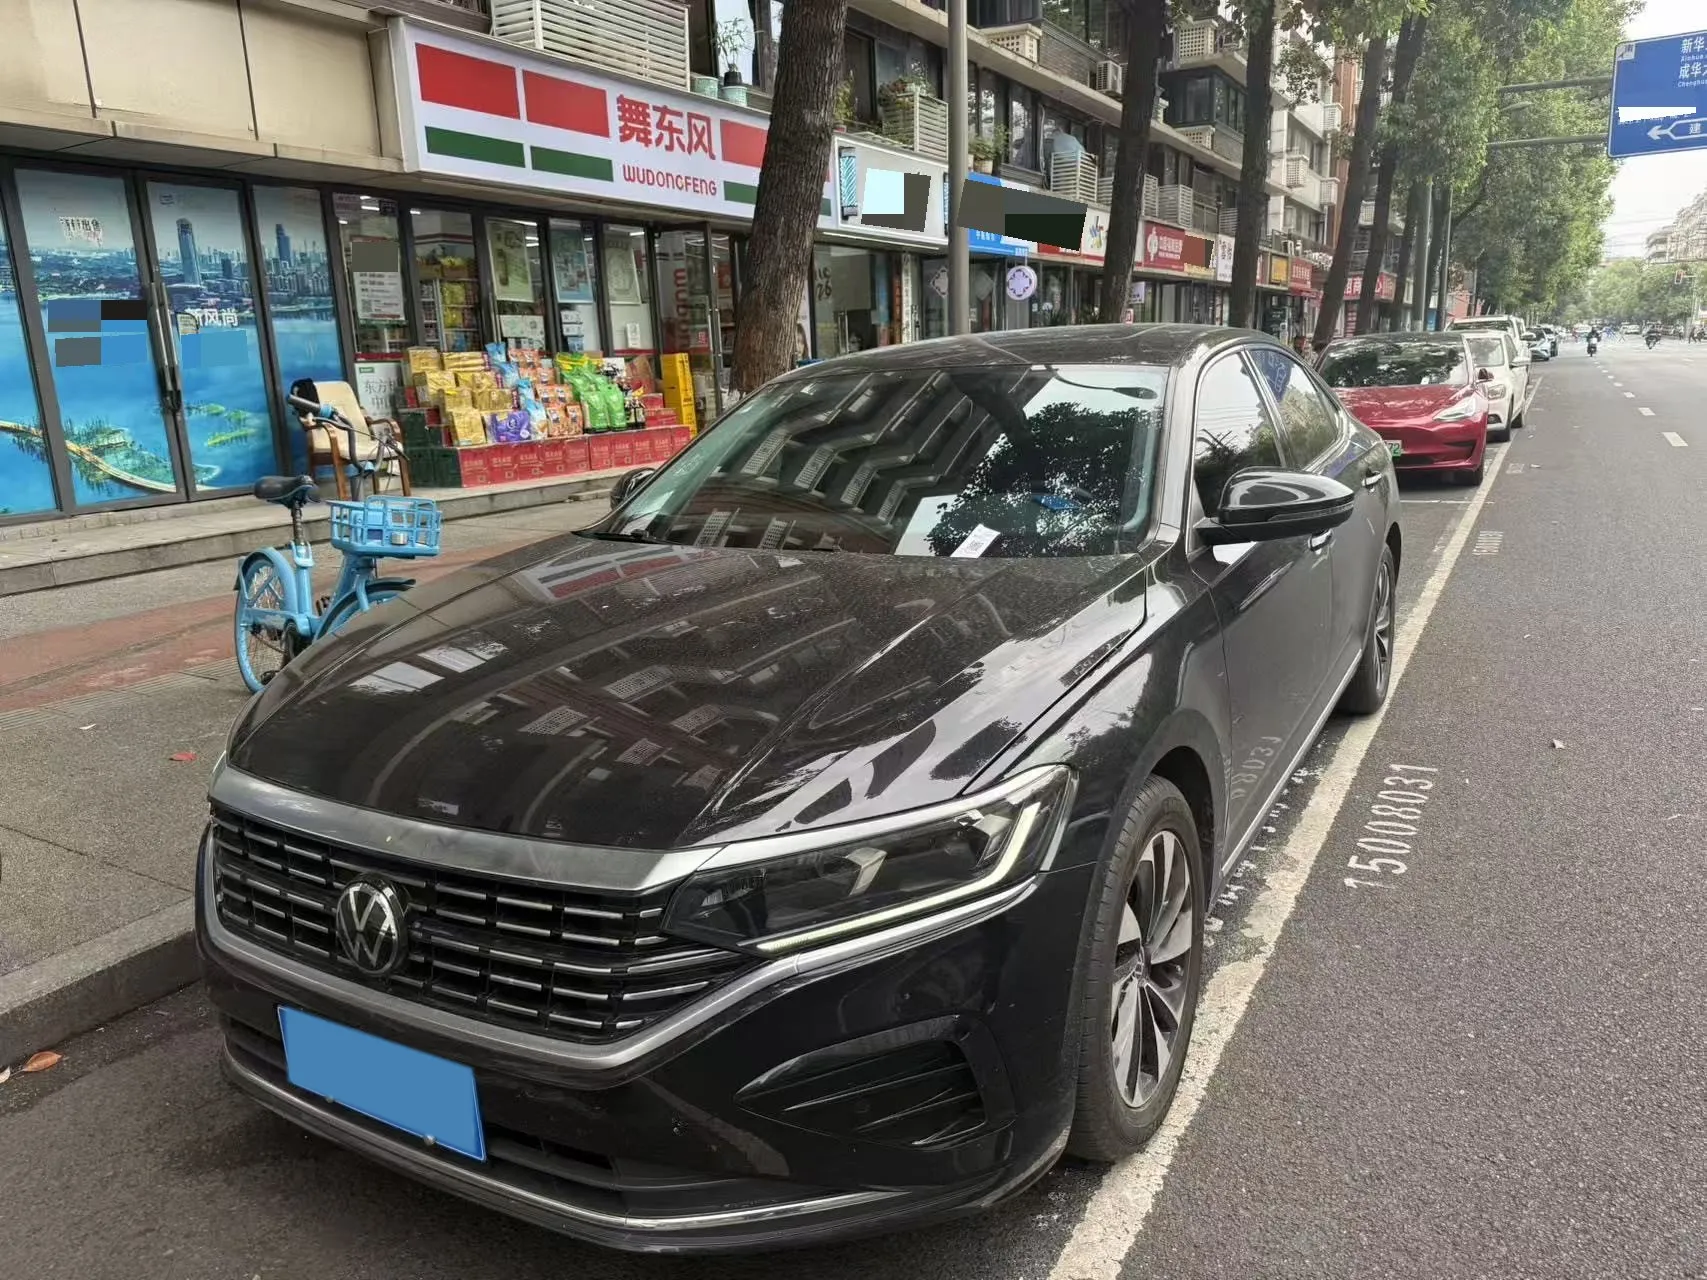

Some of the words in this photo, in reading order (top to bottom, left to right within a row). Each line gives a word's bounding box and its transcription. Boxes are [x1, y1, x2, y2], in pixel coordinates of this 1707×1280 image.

[1681, 36, 1707, 54] 新华
[617, 94, 716, 160] 舞东风
[1343, 763, 1438, 889] 15008031
